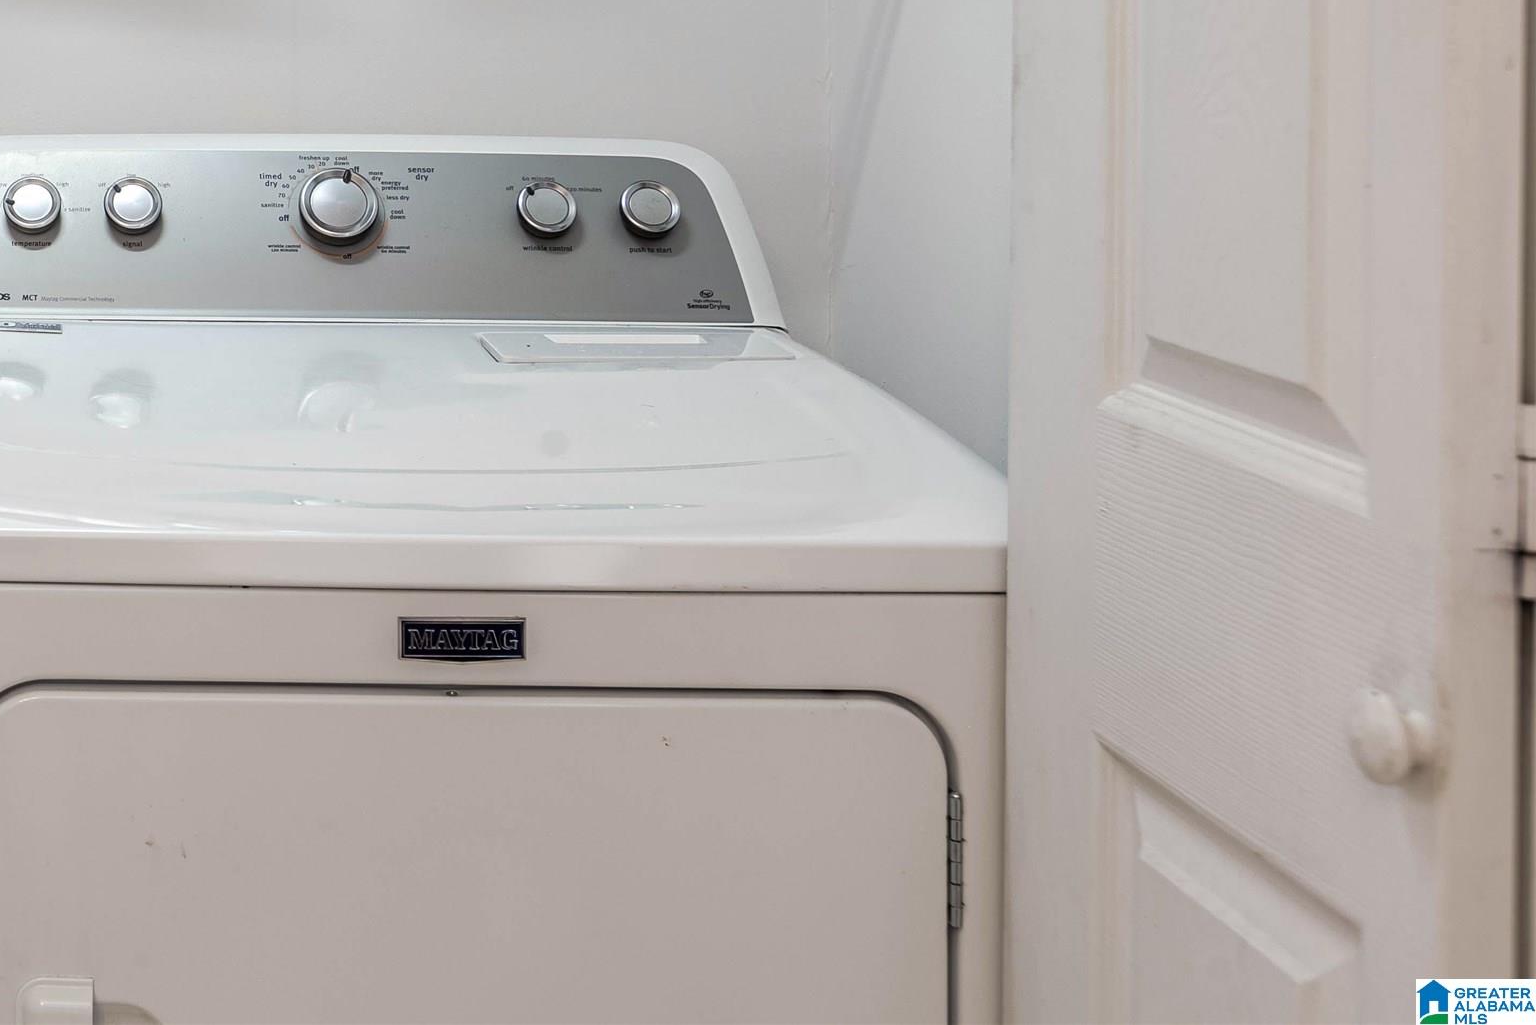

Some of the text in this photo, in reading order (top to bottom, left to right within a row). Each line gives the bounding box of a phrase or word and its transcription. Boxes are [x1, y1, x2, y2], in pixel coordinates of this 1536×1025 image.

[259, 172, 282, 180] timed
[415, 173, 429, 182] dry
[265, 180, 278, 188] dry
[278, 214, 289, 222] off
[11, 240, 52, 248] temperature
[123, 240, 143, 249] signal
[21, 294, 38, 302] MCT
[407, 628, 519, 650] MAYTAG
